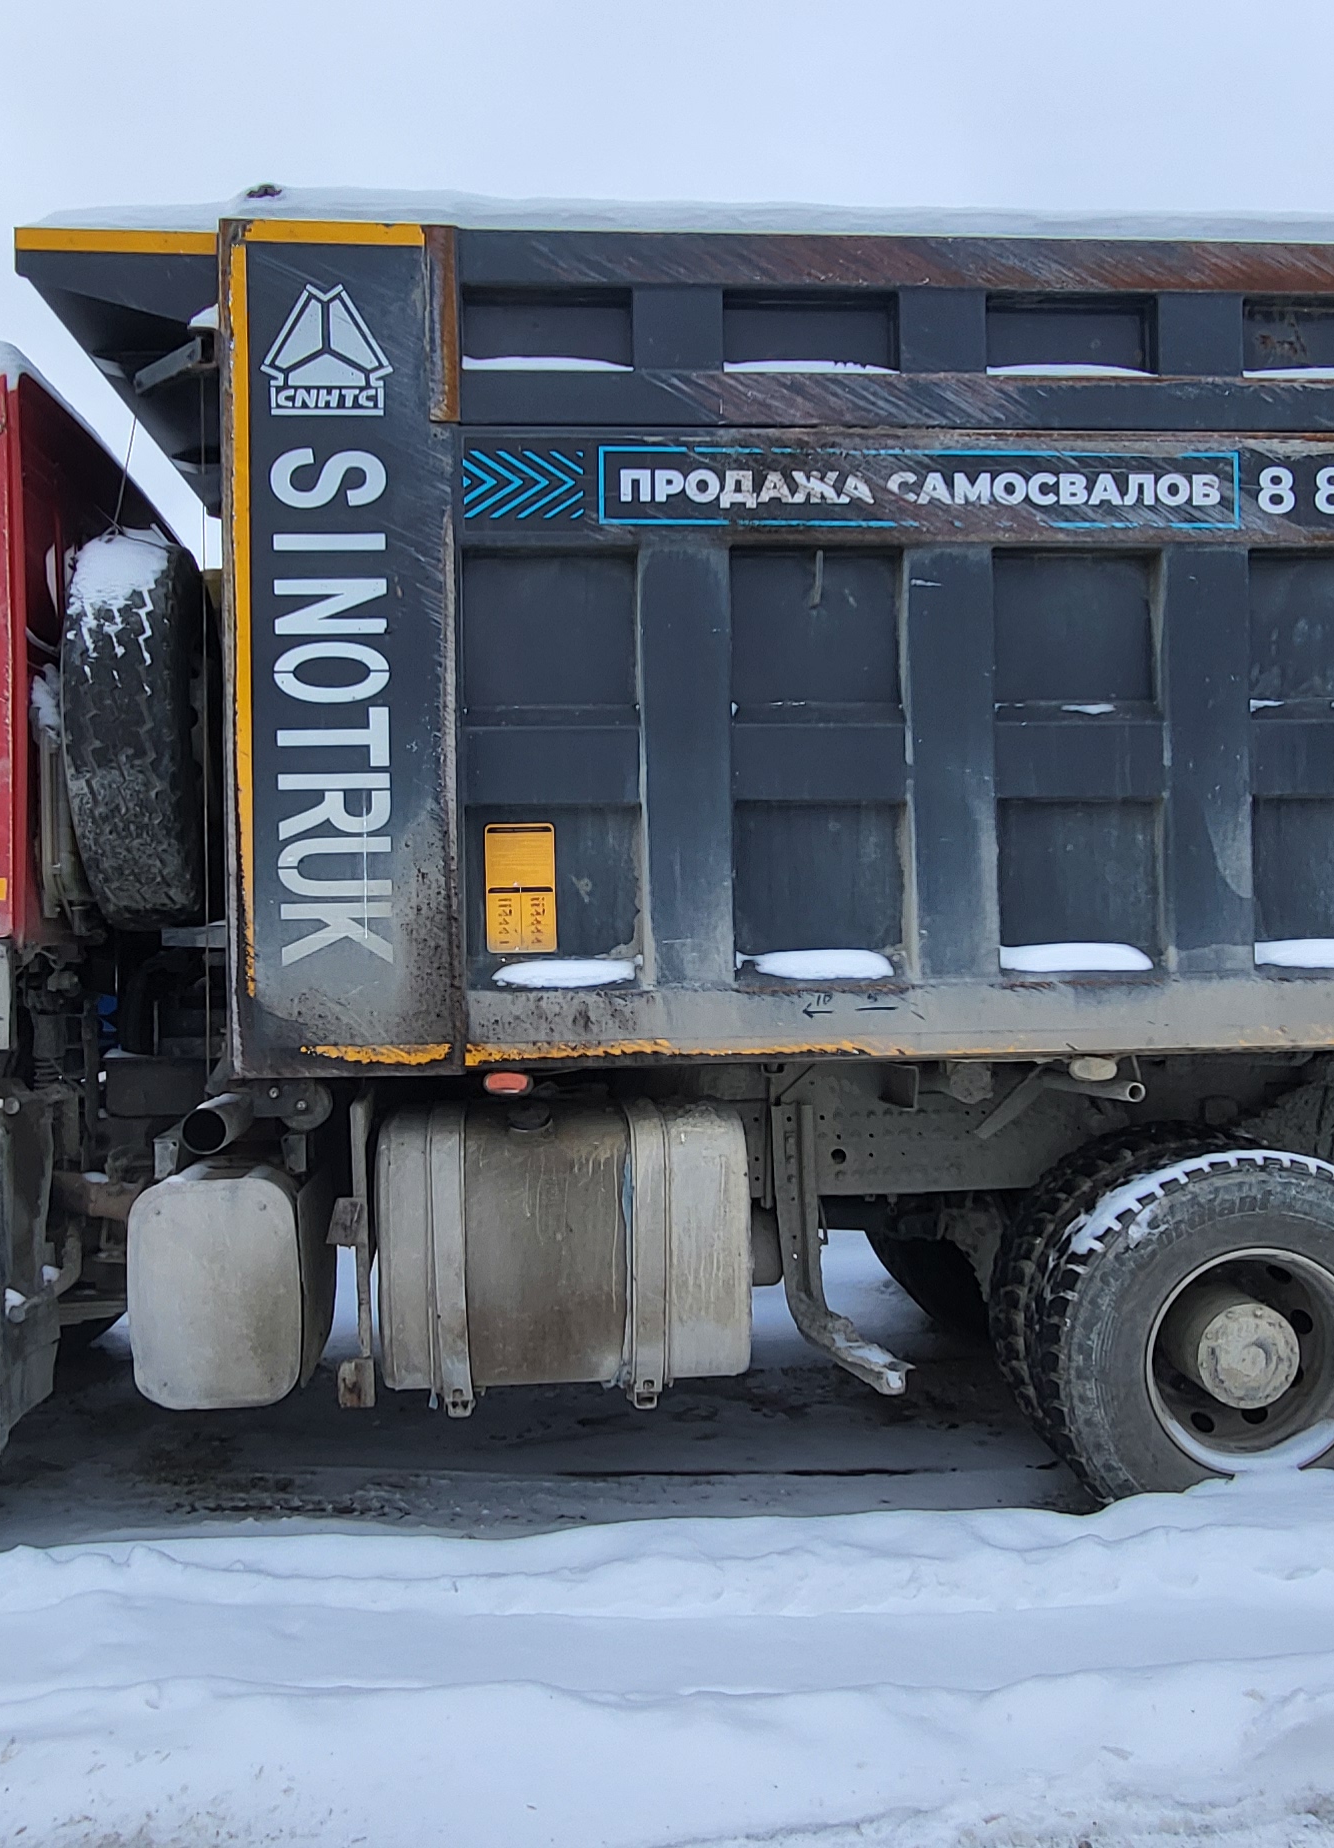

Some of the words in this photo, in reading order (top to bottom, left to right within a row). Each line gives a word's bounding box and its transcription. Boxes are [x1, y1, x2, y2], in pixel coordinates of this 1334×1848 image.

[277, 388, 376, 408] CNHTC
[619, 468, 874, 509] ПРОДАЖА
[886, 470, 1221, 506] САМОСВАЛОВ
[1256, 467, 1295, 514] 8
[269, 447, 394, 966] SINOTRUK
